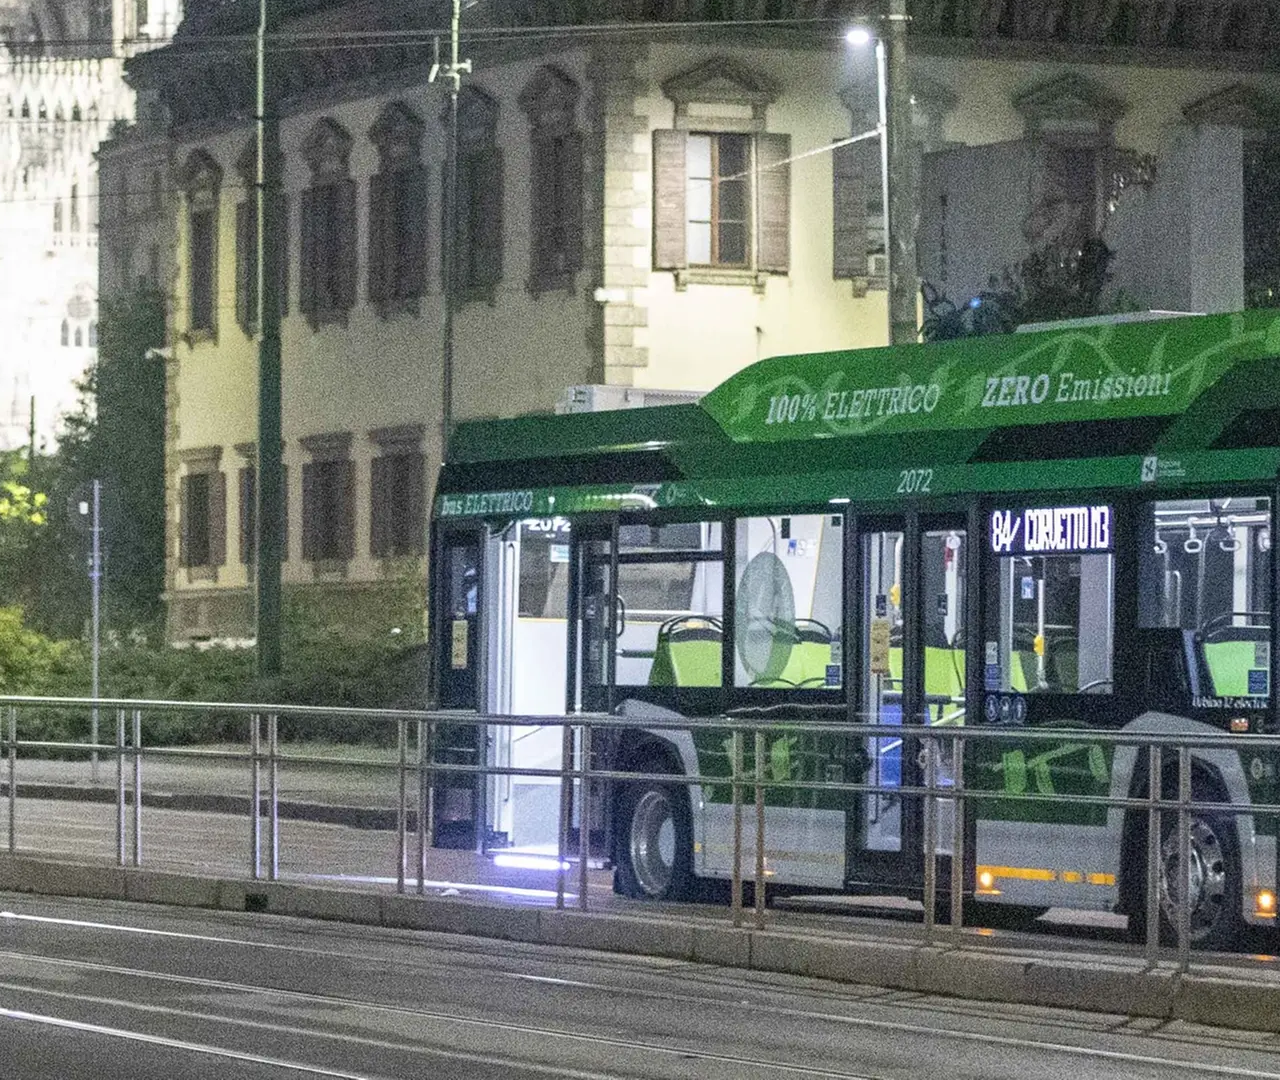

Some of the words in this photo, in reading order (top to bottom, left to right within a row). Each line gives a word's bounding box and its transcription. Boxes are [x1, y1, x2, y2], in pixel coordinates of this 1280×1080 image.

[765, 394, 817, 425] 100%
[822, 383, 942, 421] ELETTRICO
[982, 374, 1051, 408] ZERO
[1057, 366, 1174, 403] Emissioni
[897, 469, 933, 493] 2072
[441, 496, 462, 515] bus
[464, 491, 533, 514] ELETTRICO
[1024, 507, 1089, 551] CORVETTO
